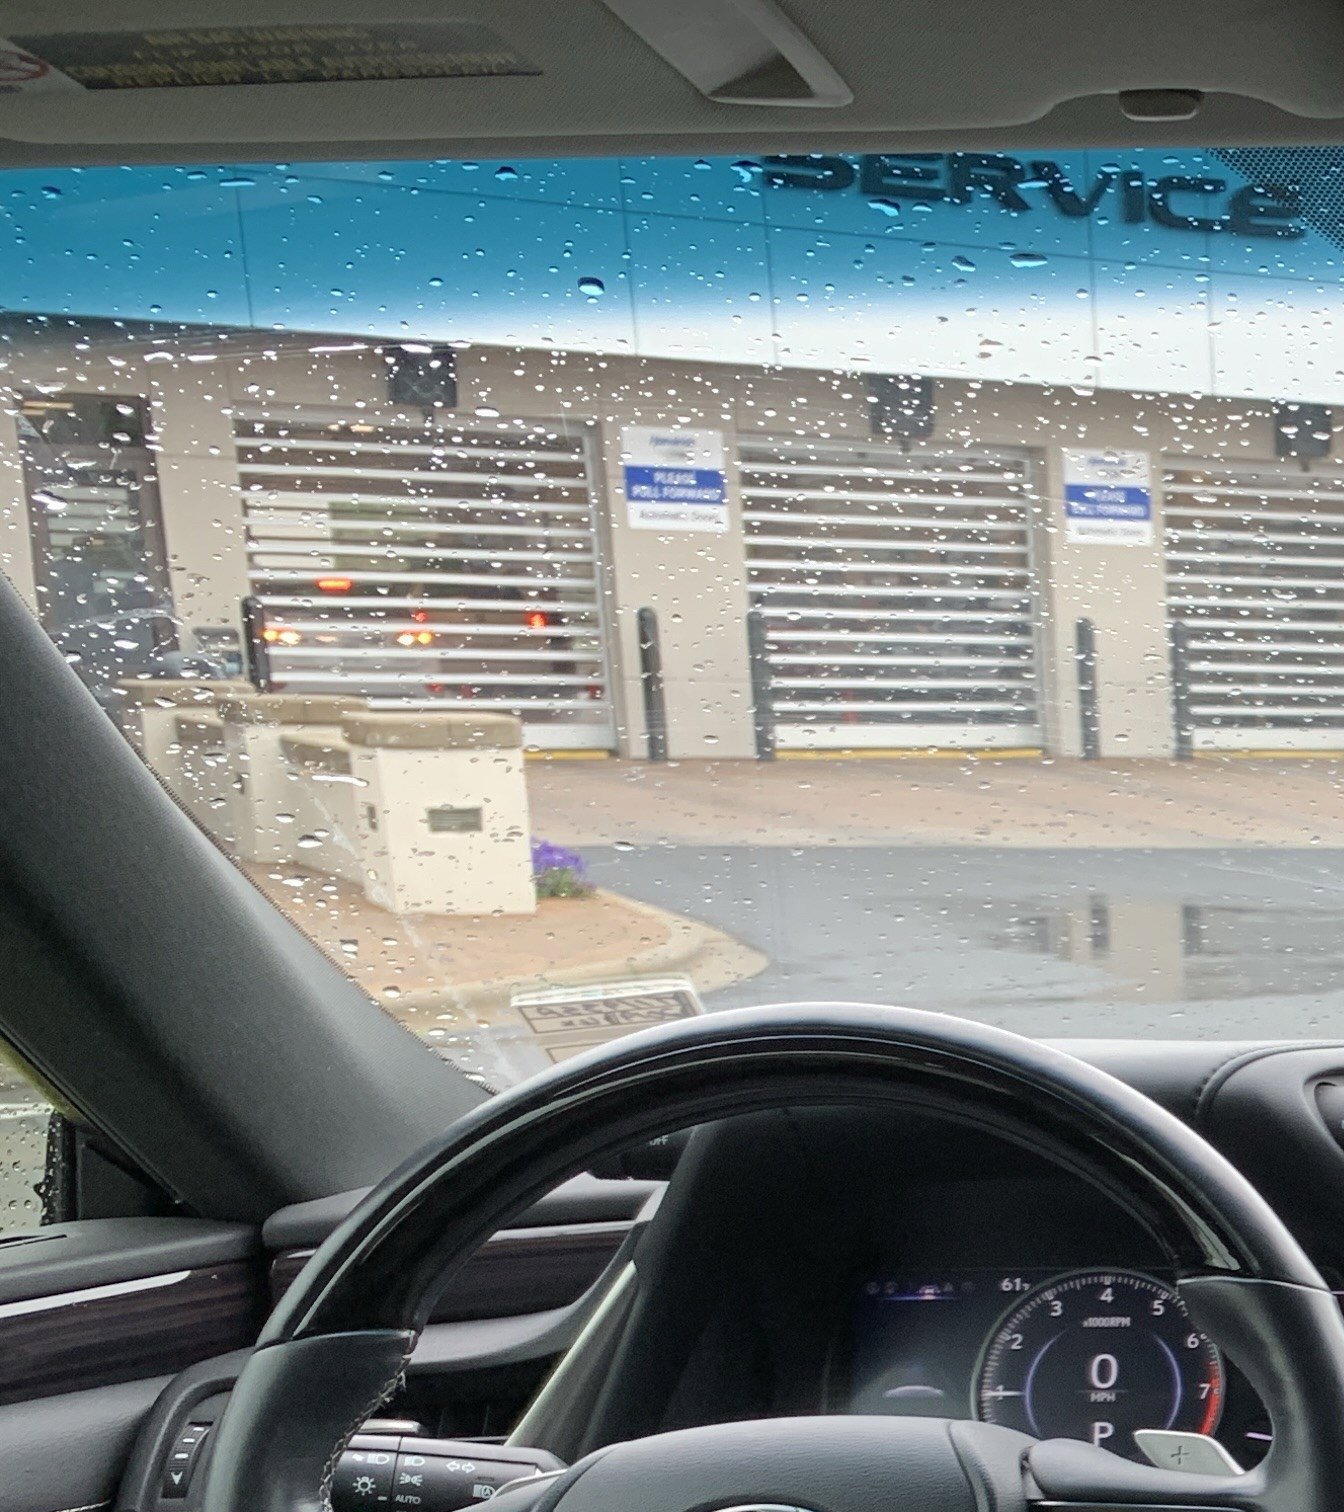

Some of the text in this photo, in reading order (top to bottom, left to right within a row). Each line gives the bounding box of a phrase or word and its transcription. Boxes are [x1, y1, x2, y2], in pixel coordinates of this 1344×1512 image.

[761, 153, 1305, 240] SERVICE
[1099, 1287, 1114, 1303] 4
[1050, 1300, 1063, 1317] 3
[1151, 1300, 1165, 1316] 5
[1010, 1333, 1024, 1350] 2
[1187, 1332, 1200, 1349] 6
[1090, 1353, 1119, 1389] 0
[1089, 1392, 1116, 1403] MPH
[1199, 1383, 1211, 1400] 7
[1093, 1421, 1115, 1448] P
[395, 1494, 422, 1505] AUTO
